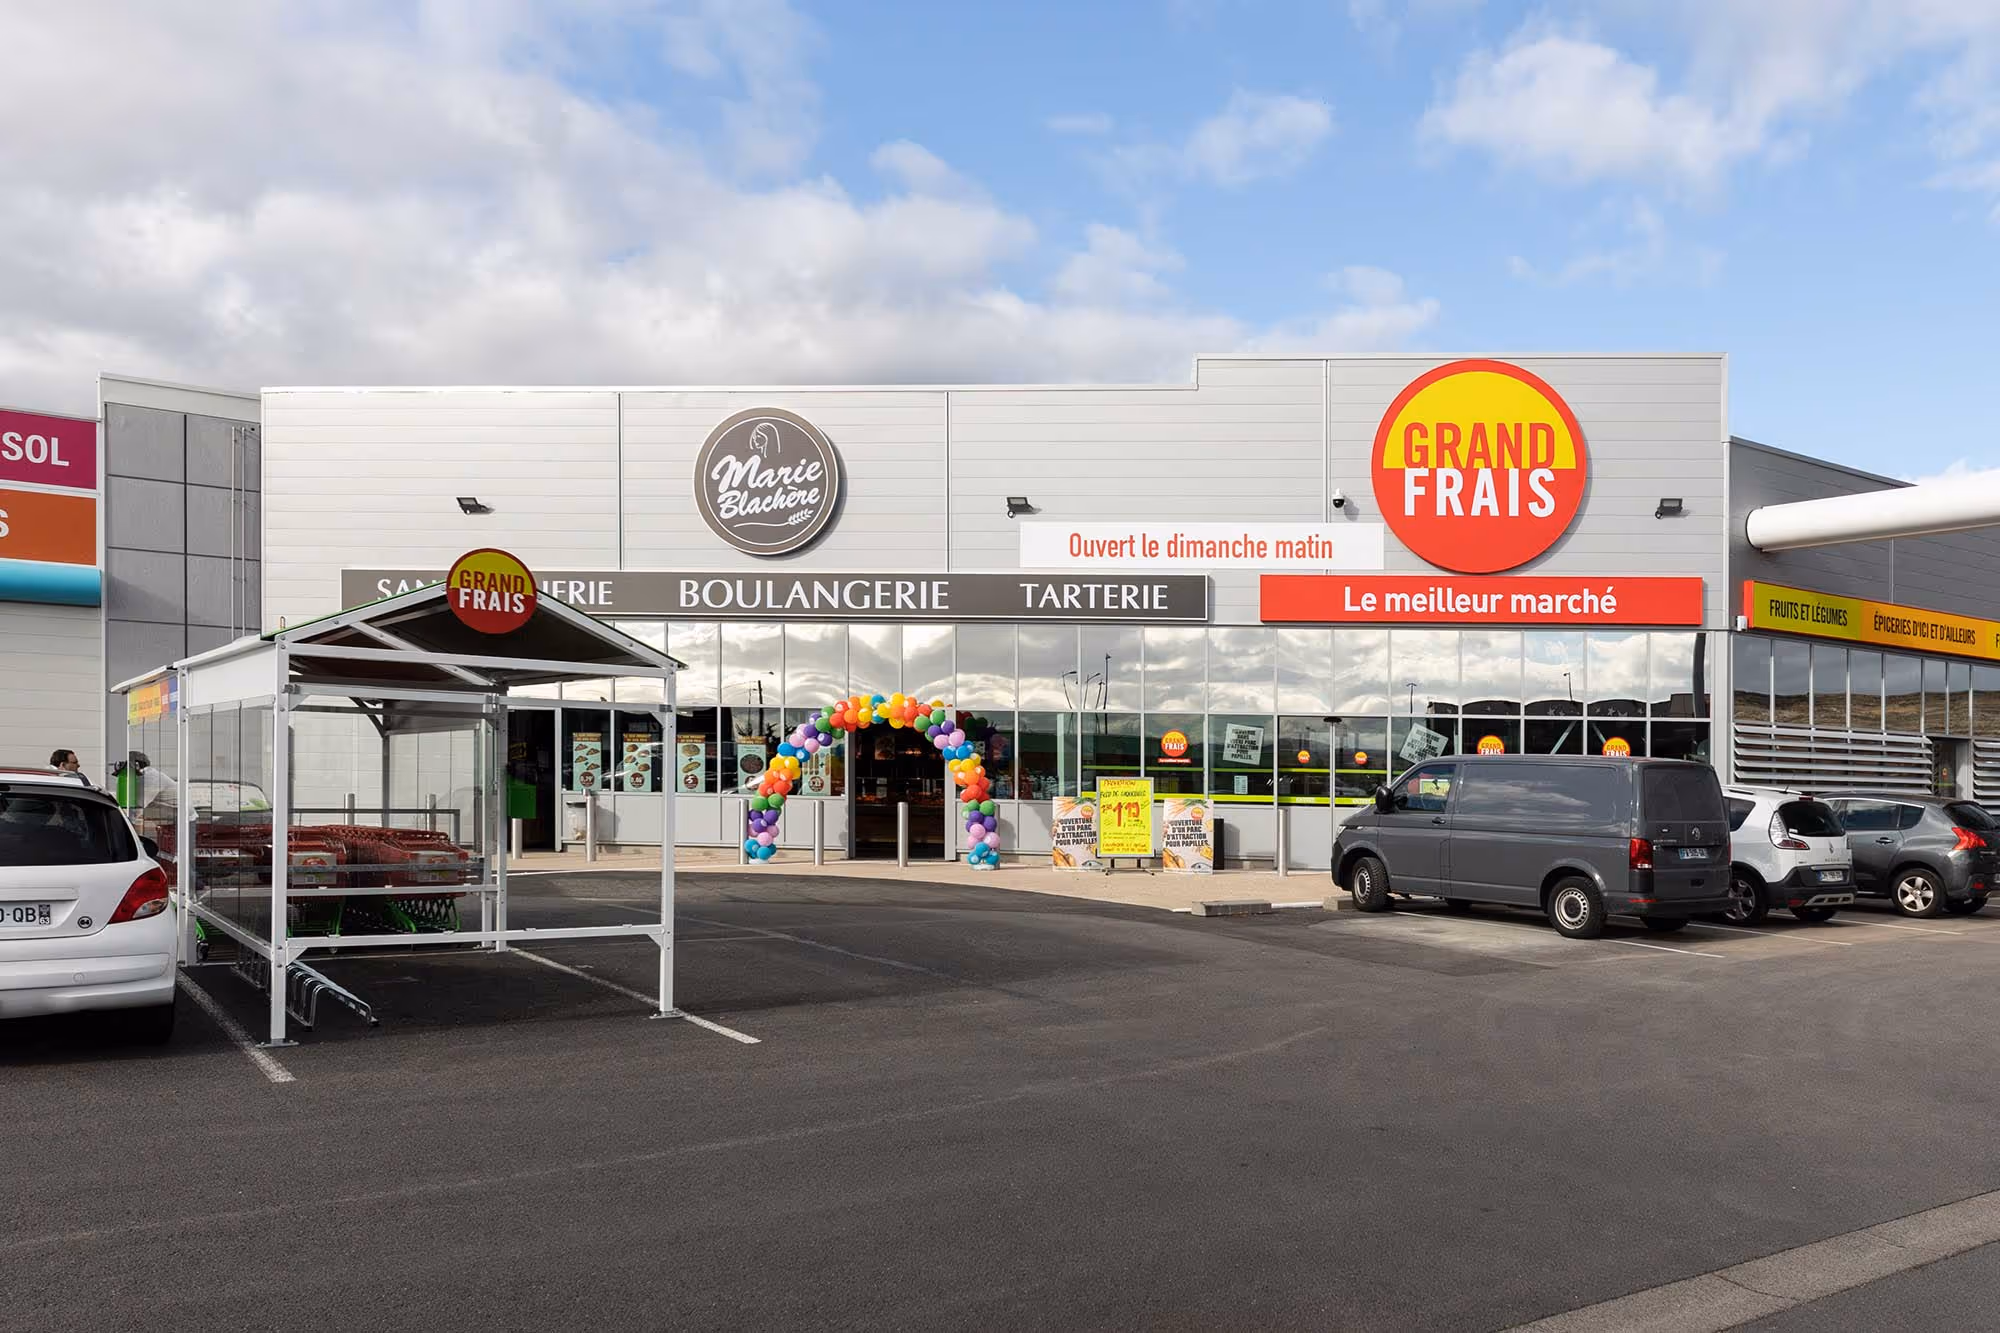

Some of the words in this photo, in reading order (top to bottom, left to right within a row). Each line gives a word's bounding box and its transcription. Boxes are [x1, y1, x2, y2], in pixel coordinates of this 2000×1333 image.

[1, 431, 70, 467] SOL
[1404, 422, 1555, 469] GRAND
[711, 454, 823, 493] Marie
[717, 485, 820, 519] Blachère
[1404, 467, 1556, 518] FRAIS
[1069, 532, 1136, 559] Ouvert
[1142, 533, 1159, 559] le
[1166, 533, 1268, 560] dimanche
[1275, 533, 1333, 560] matin
[459, 569, 525, 597] GRAND
[678, 579, 950, 610] BOULANGERIE
[1019, 583, 1169, 610] TARTERIE
[458, 587, 526, 614] FRAIS
[1344, 586, 1377, 612] Le
[1385, 586, 1503, 613] meilleur
[1510, 585, 1618, 614] marché
[1769, 599, 1799, 620] FRUITS
[1800, 606, 1811, 621] ET
[1811, 602, 1848, 627] LÉGUMES
[1873, 610, 1912, 636] ÉPICERIES
[1912, 620, 1929, 638] D'ICI
[1930, 624, 1939, 640] ET
[1939, 624, 1976, 646] D'AILLEURS
[1056, 831, 1097, 839] D'ATTRACTION
[1060, 817, 1093, 825] OUVERTURE
[1170, 819, 1203, 827] OUVERTURE
[1166, 832, 1207, 840] D'ATTRACTION
[40, 916, 50, 924] 63
